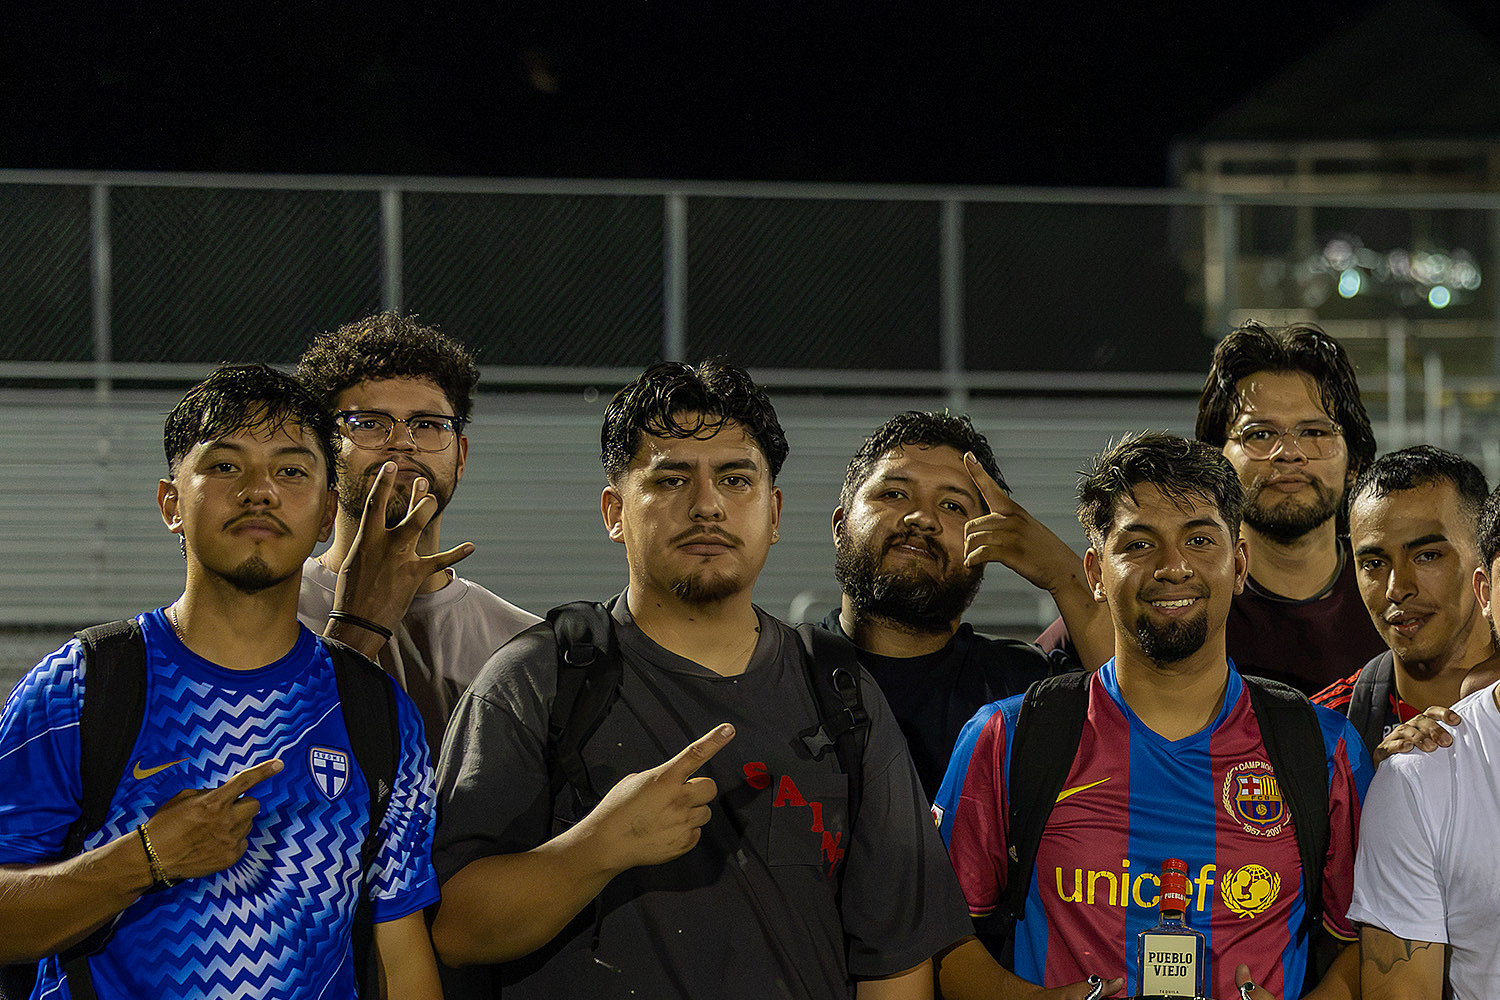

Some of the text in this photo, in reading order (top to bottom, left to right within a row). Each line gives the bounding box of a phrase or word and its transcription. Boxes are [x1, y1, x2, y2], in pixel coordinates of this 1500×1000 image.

[1238, 760, 1261, 771] CAMP
[1148, 951, 1193, 964] PUEBLO
[1153, 964, 1188, 977] VIEJO
